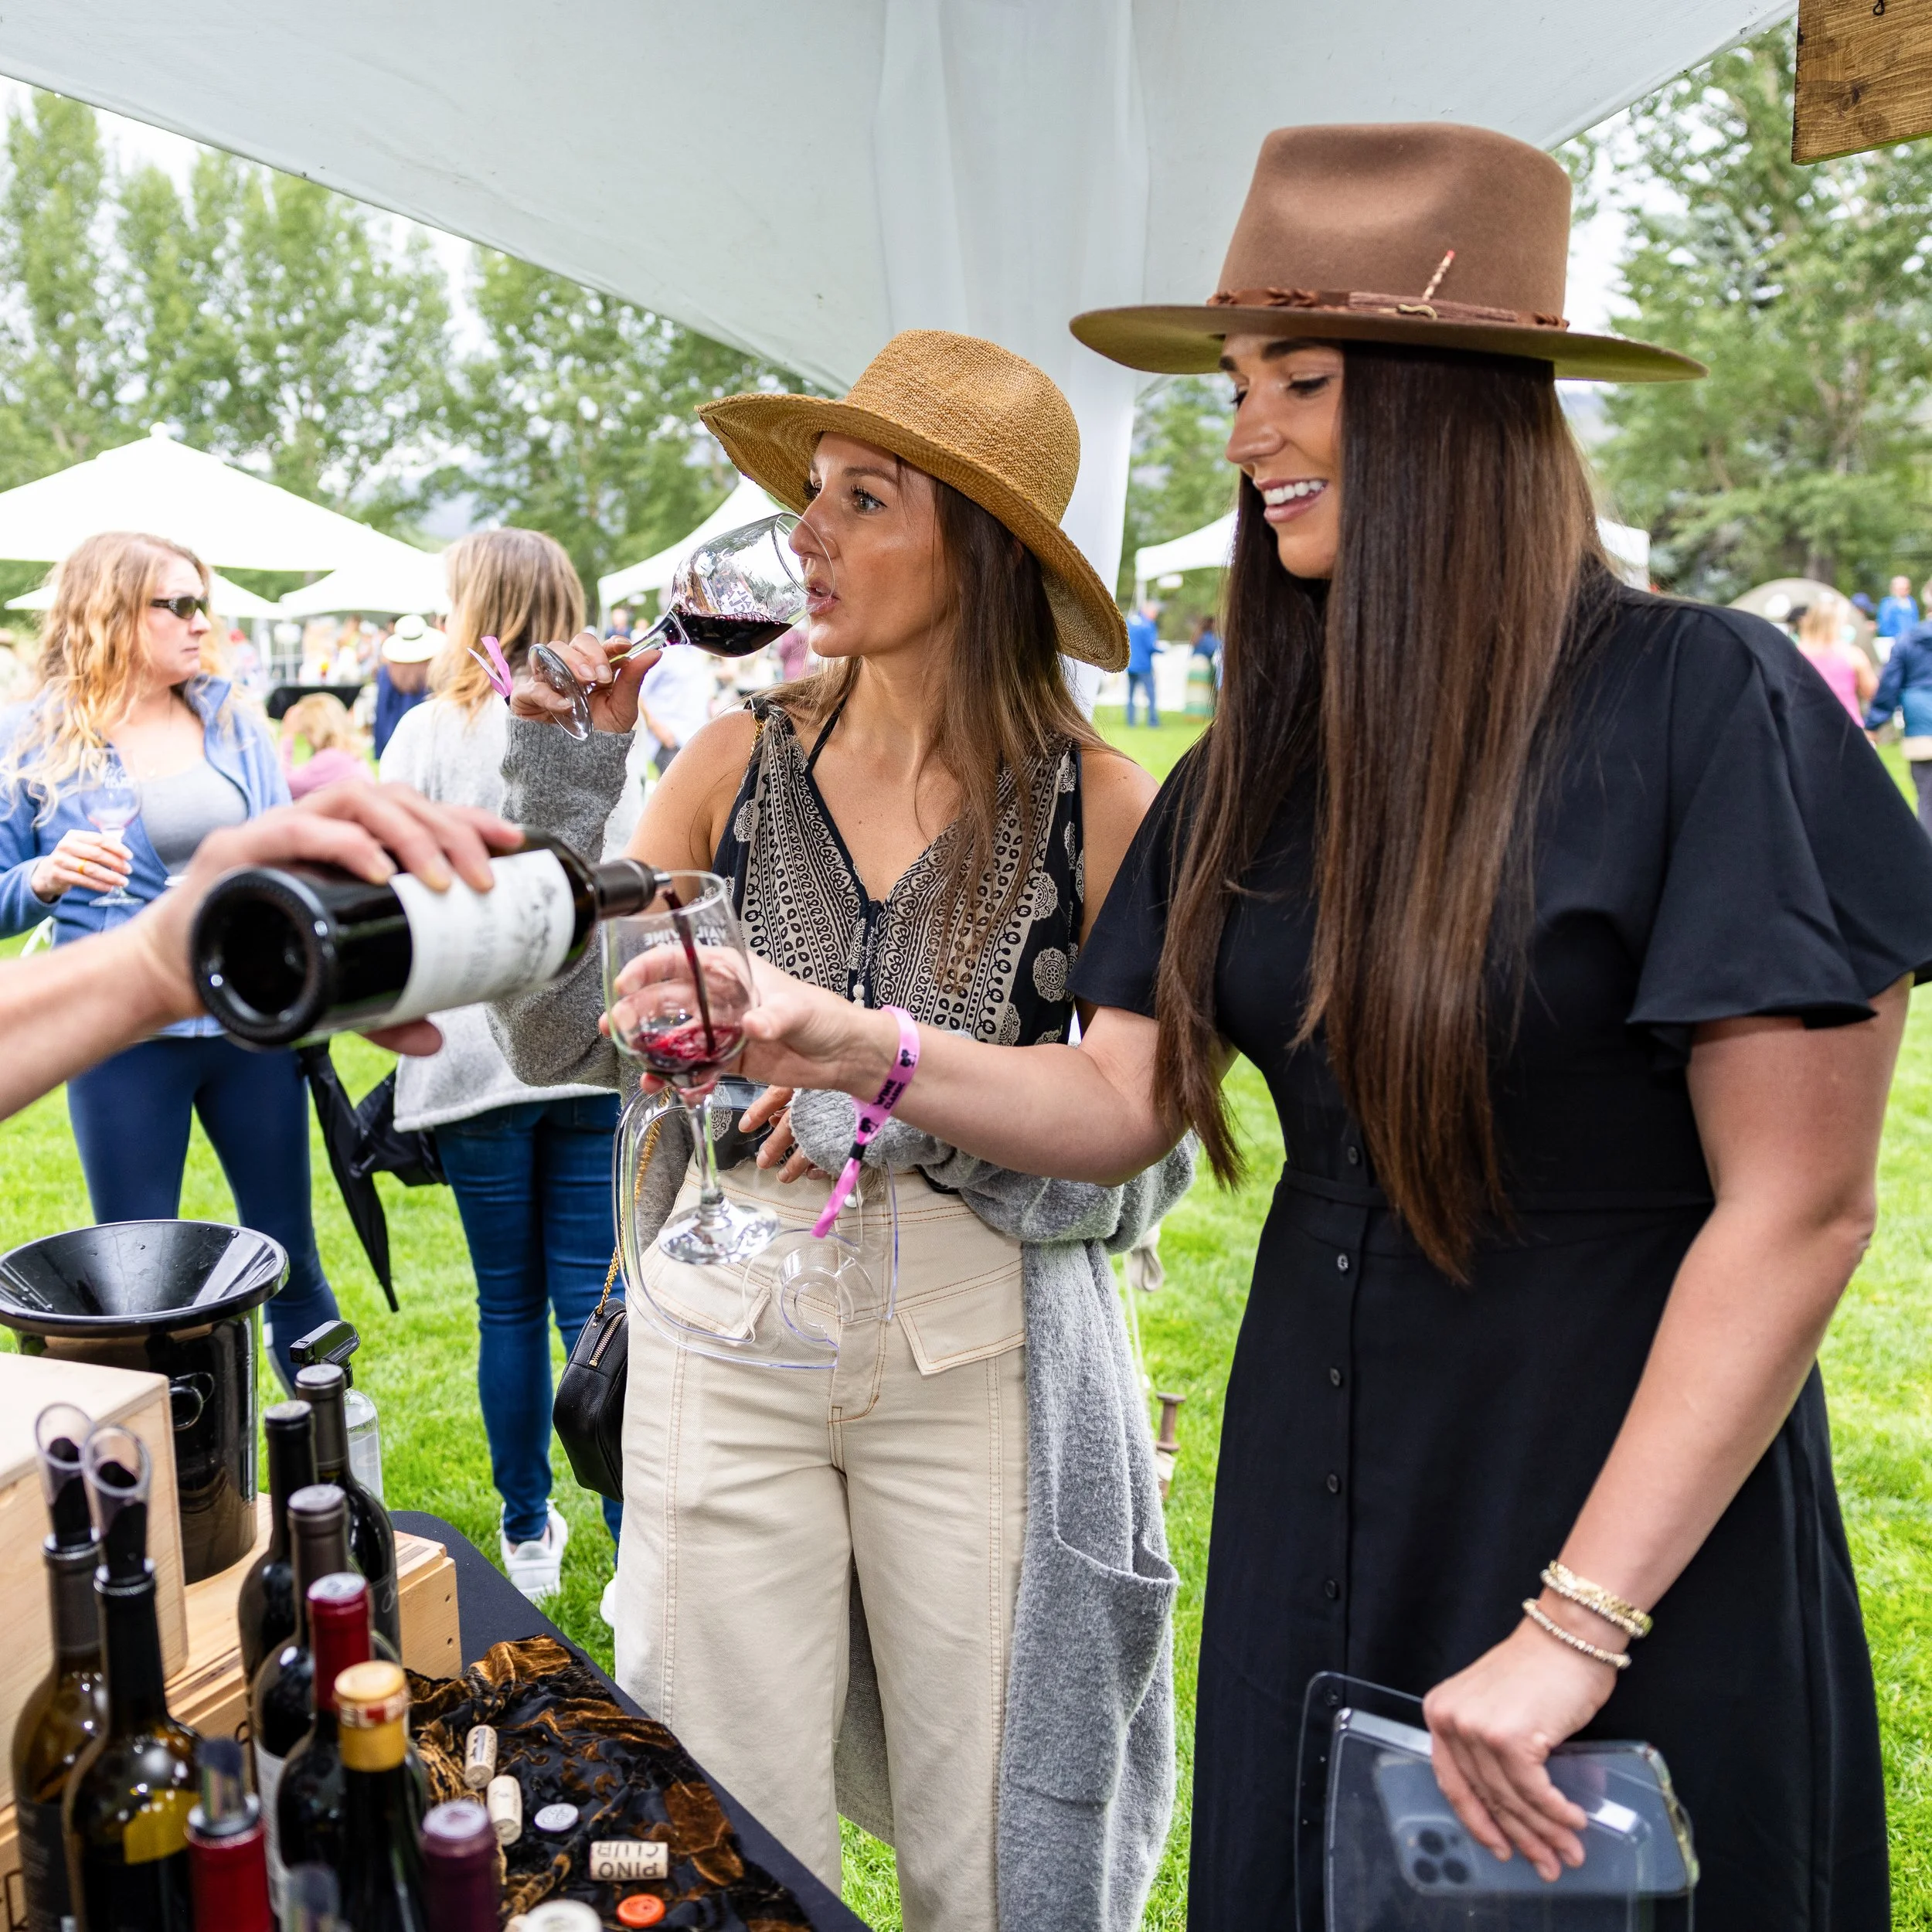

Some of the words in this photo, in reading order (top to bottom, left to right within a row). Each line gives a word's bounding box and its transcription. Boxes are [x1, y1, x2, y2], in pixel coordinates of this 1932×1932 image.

[872, 1079, 896, 1106] WINE
[597, 1842, 659, 1858] CLUB
[598, 1862, 658, 1879] PINO
